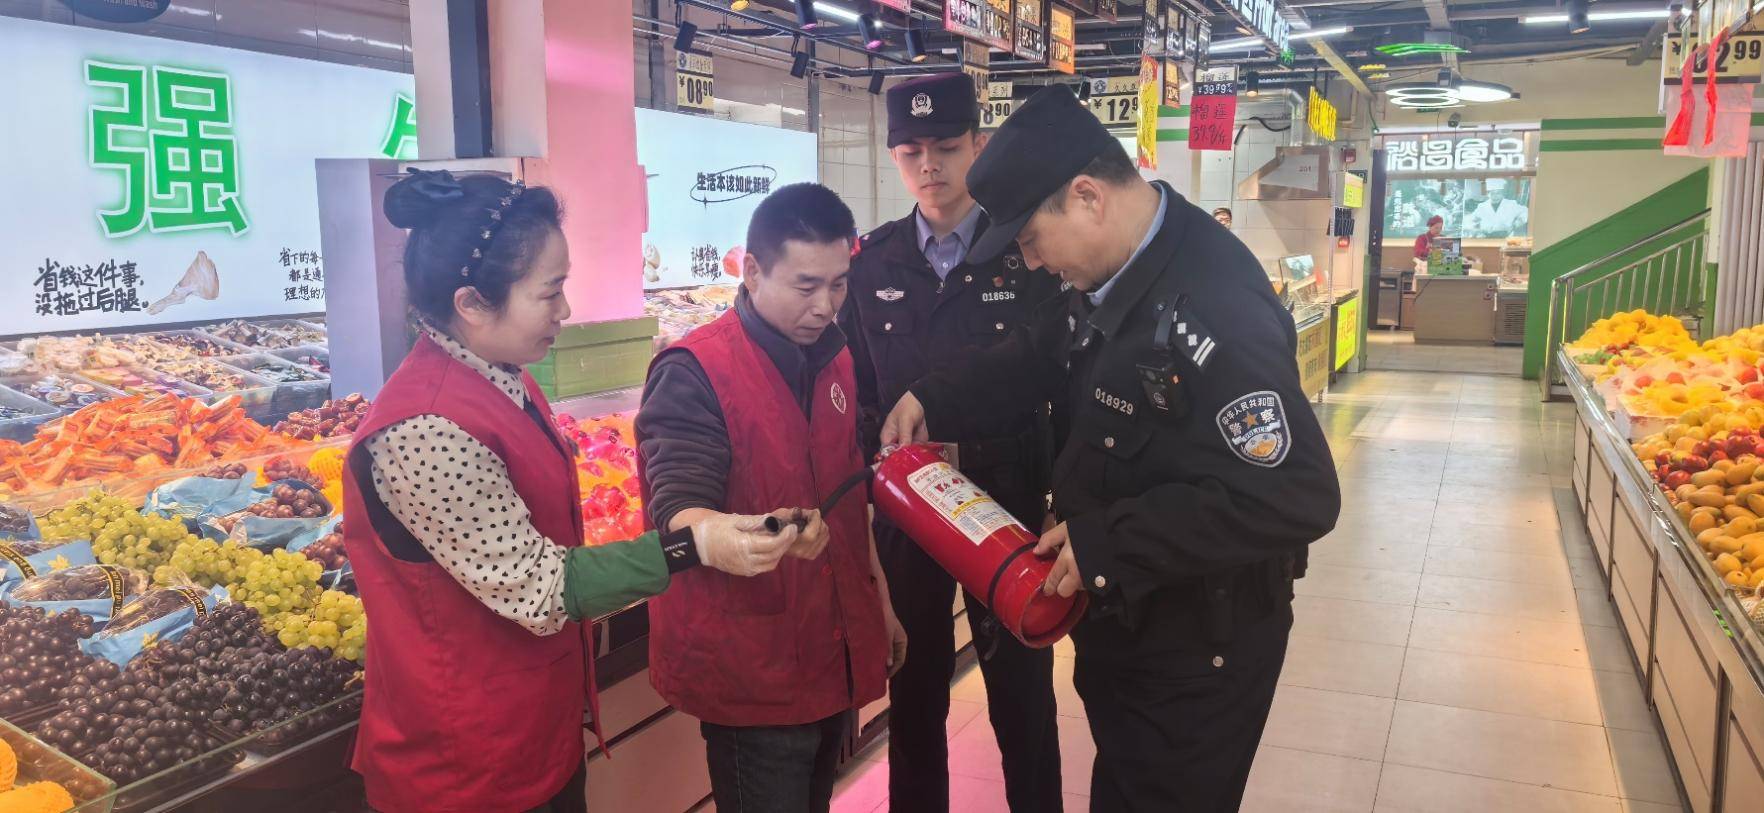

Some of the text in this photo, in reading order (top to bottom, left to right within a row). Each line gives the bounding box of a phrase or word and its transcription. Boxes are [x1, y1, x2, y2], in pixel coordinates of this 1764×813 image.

[84, 60, 249, 238] 强
[697, 172, 770, 195] 生活本该如此新鲜
[289, 267, 324, 282] 都是通
[283, 284, 325, 301] 理想的
[1095, 387, 1134, 416] 018929
[1221, 396, 1275, 426] 中华人民共和国
